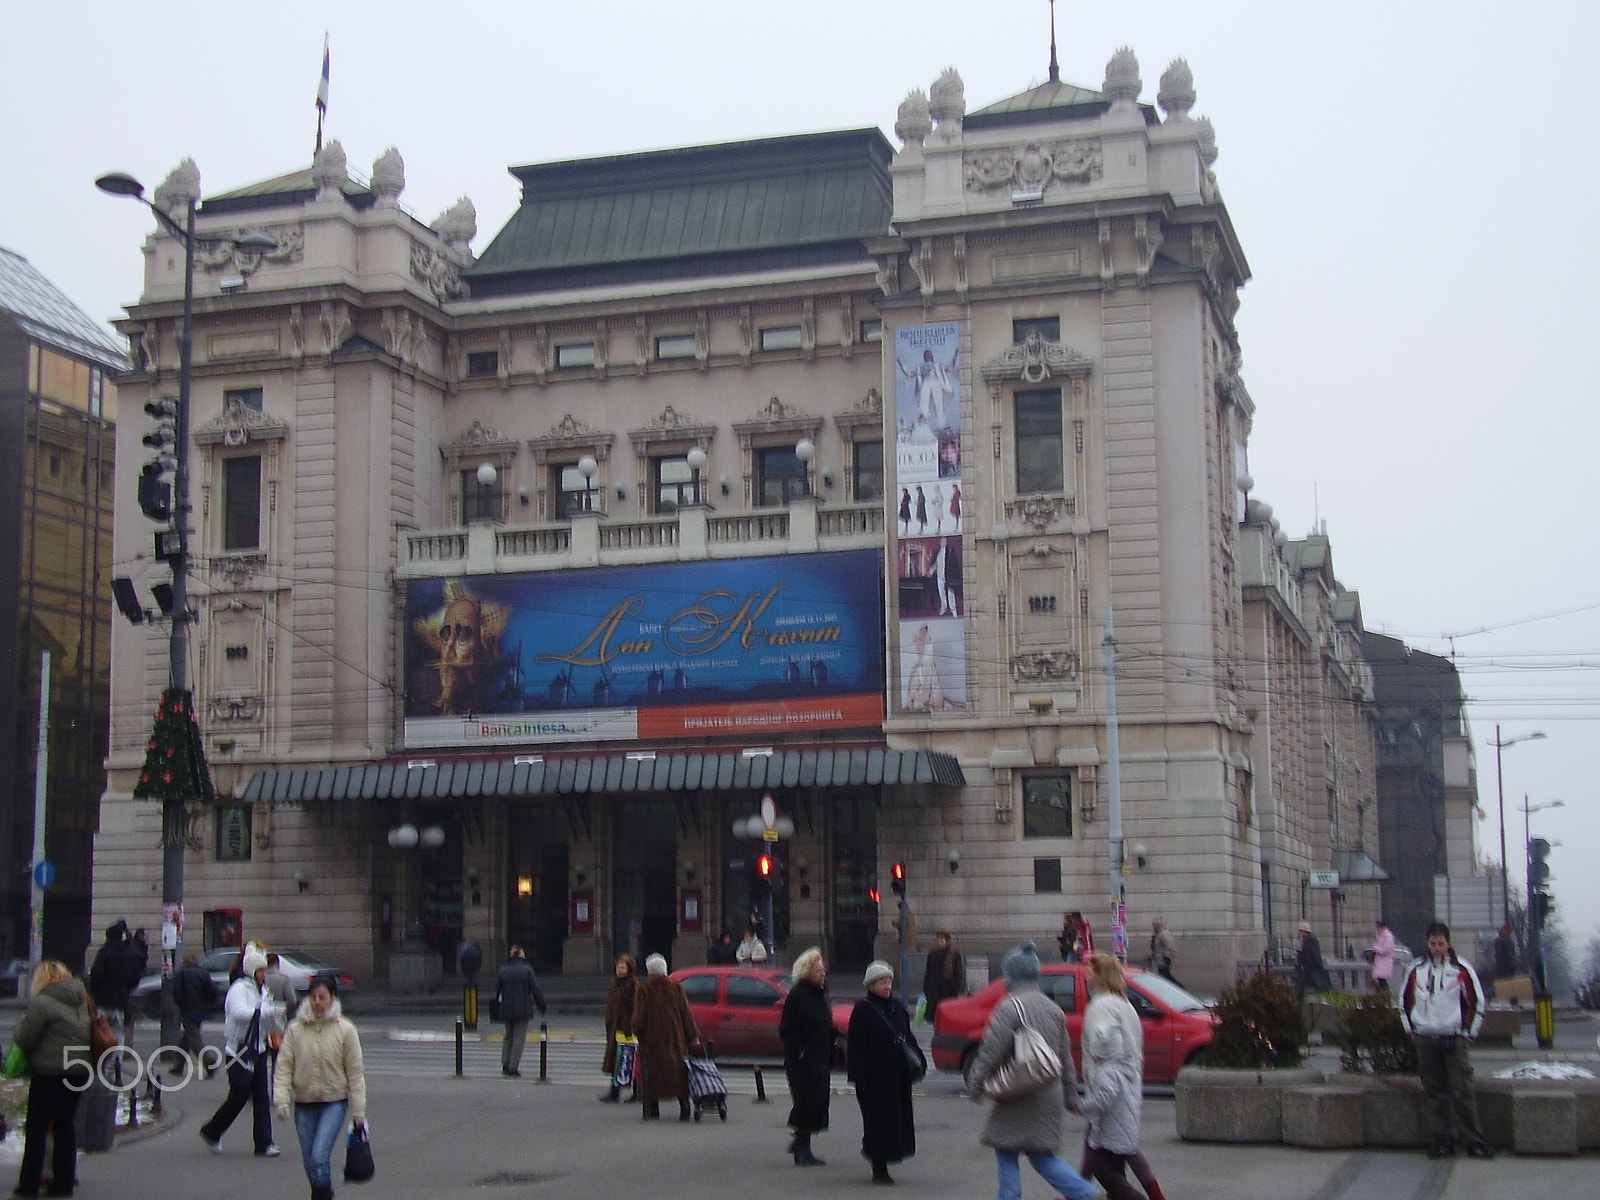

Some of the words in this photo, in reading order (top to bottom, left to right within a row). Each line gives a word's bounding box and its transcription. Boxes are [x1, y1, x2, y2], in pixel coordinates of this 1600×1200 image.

[536, 595, 652, 669] Дон
[684, 717, 733, 729] ПРИЈАТЕЉ
[735, 714, 782, 726] НАРОДНОГ
[785, 710, 843, 723] ПОЗОРИШТА
